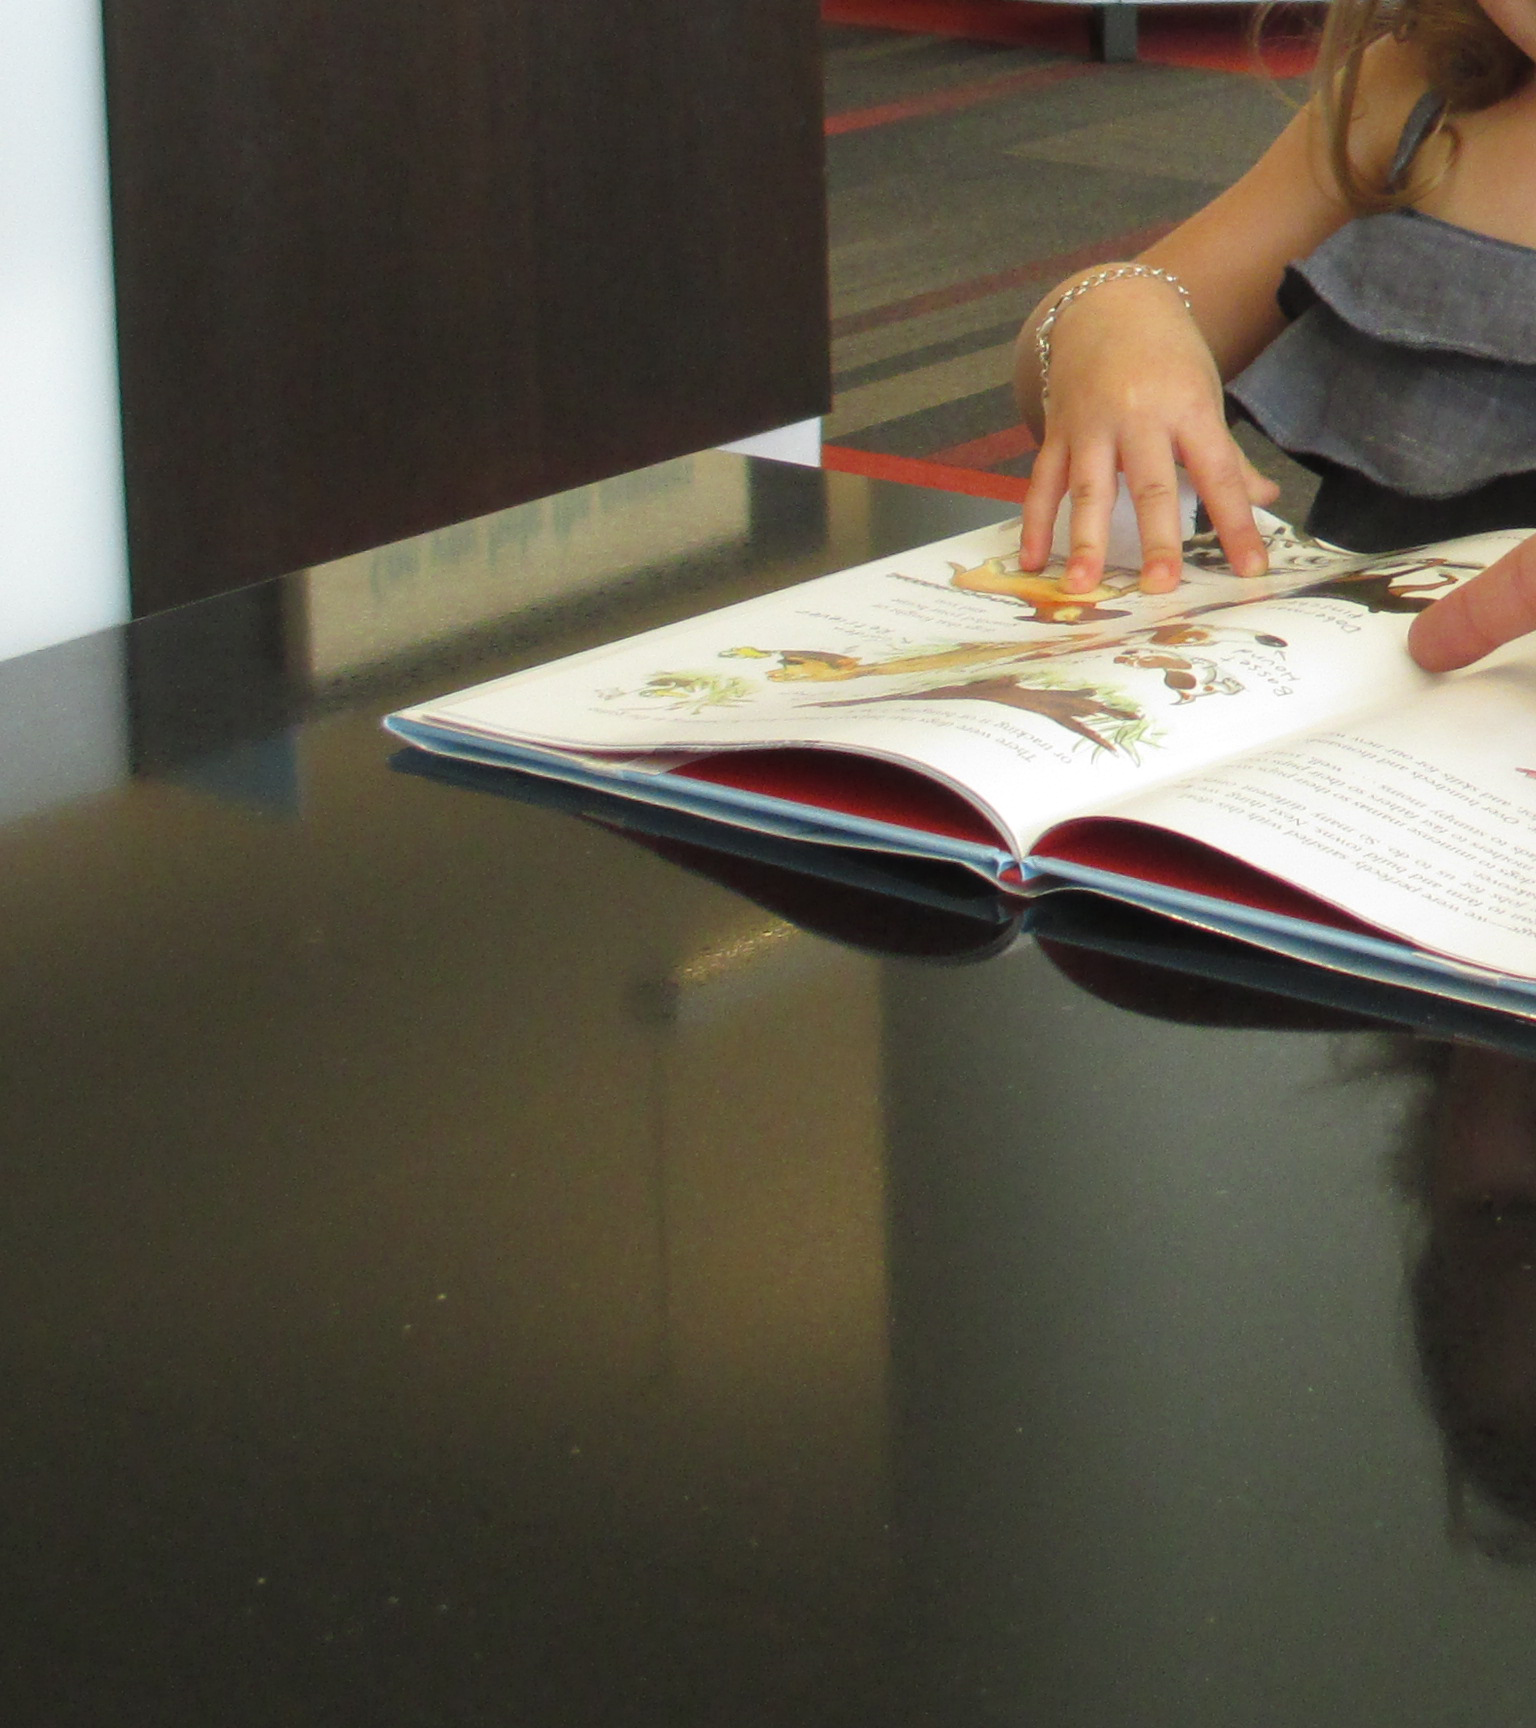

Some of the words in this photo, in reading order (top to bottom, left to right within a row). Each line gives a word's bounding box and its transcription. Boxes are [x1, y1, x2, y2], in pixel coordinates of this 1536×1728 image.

[1218, 657, 1293, 697] Basset
[956, 725, 992, 739] were
[994, 721, 1053, 751] tracking
[995, 738, 1037, 763] There
[1376, 755, 1408, 776] and
[1412, 771, 1480, 810] hundreds
[1269, 807, 1306, 829] Next
[1352, 799, 1405, 829] mamas
[1370, 792, 1419, 823] fathers
[1481, 803, 1519, 828] Over
[1248, 812, 1282, 833] with
[1312, 809, 1354, 834] many
[1421, 817, 1447, 836] fast
[1430, 805, 1485, 839] stumpy
[1283, 827, 1347, 864] satisfied
[1408, 826, 1476, 862] immense
[1362, 849, 1406, 877] build
[1471, 841, 1533, 874] mothers
[1355, 860, 1421, 898] perfectly
[1407, 870, 1442, 893] and
[1459, 879, 1485, 896] for
[1421, 891, 1460, 913] were
[1446, 888, 1482, 910] farm
